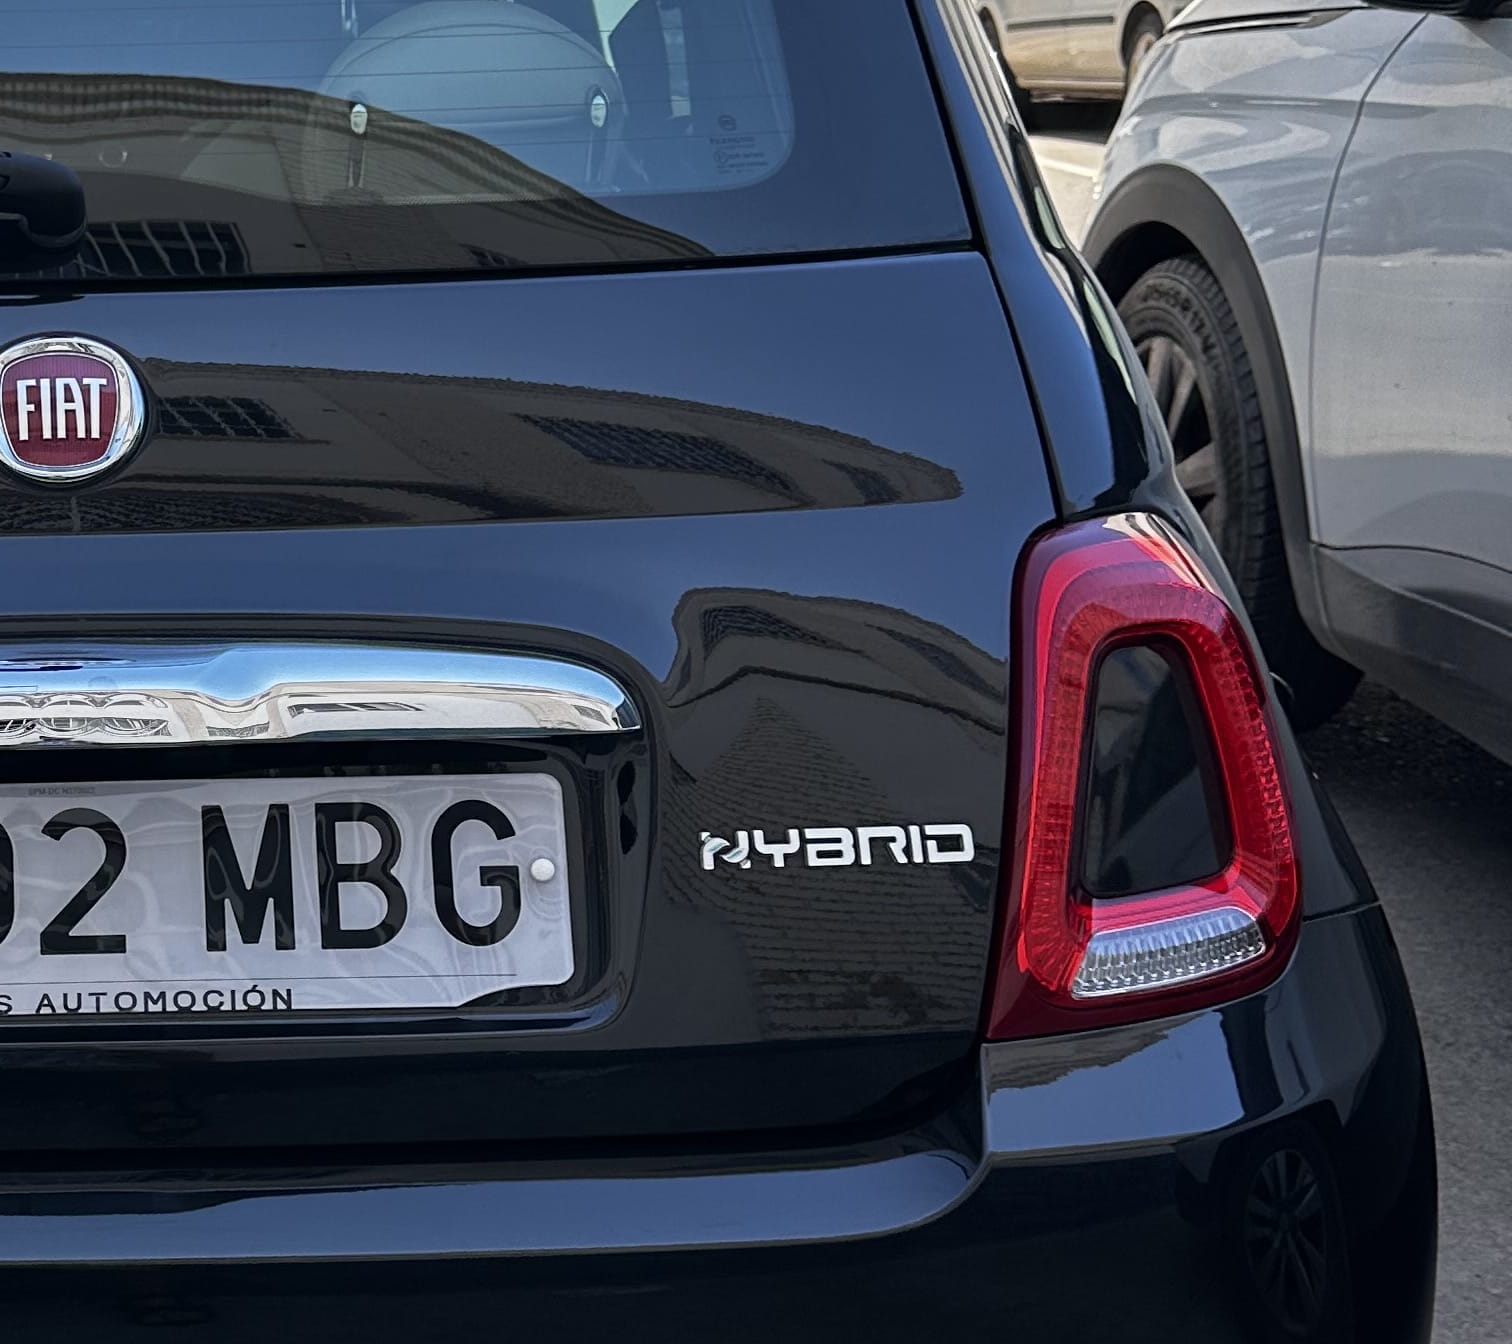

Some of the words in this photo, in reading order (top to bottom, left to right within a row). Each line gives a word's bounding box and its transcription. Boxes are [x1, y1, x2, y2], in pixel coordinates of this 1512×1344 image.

[16, 377, 107, 441] FIAT
[699, 823, 976, 870] HYBRID
[201, 799, 522, 952] MBG
[35, 984, 293, 1014] AUTOMOCIÓN
